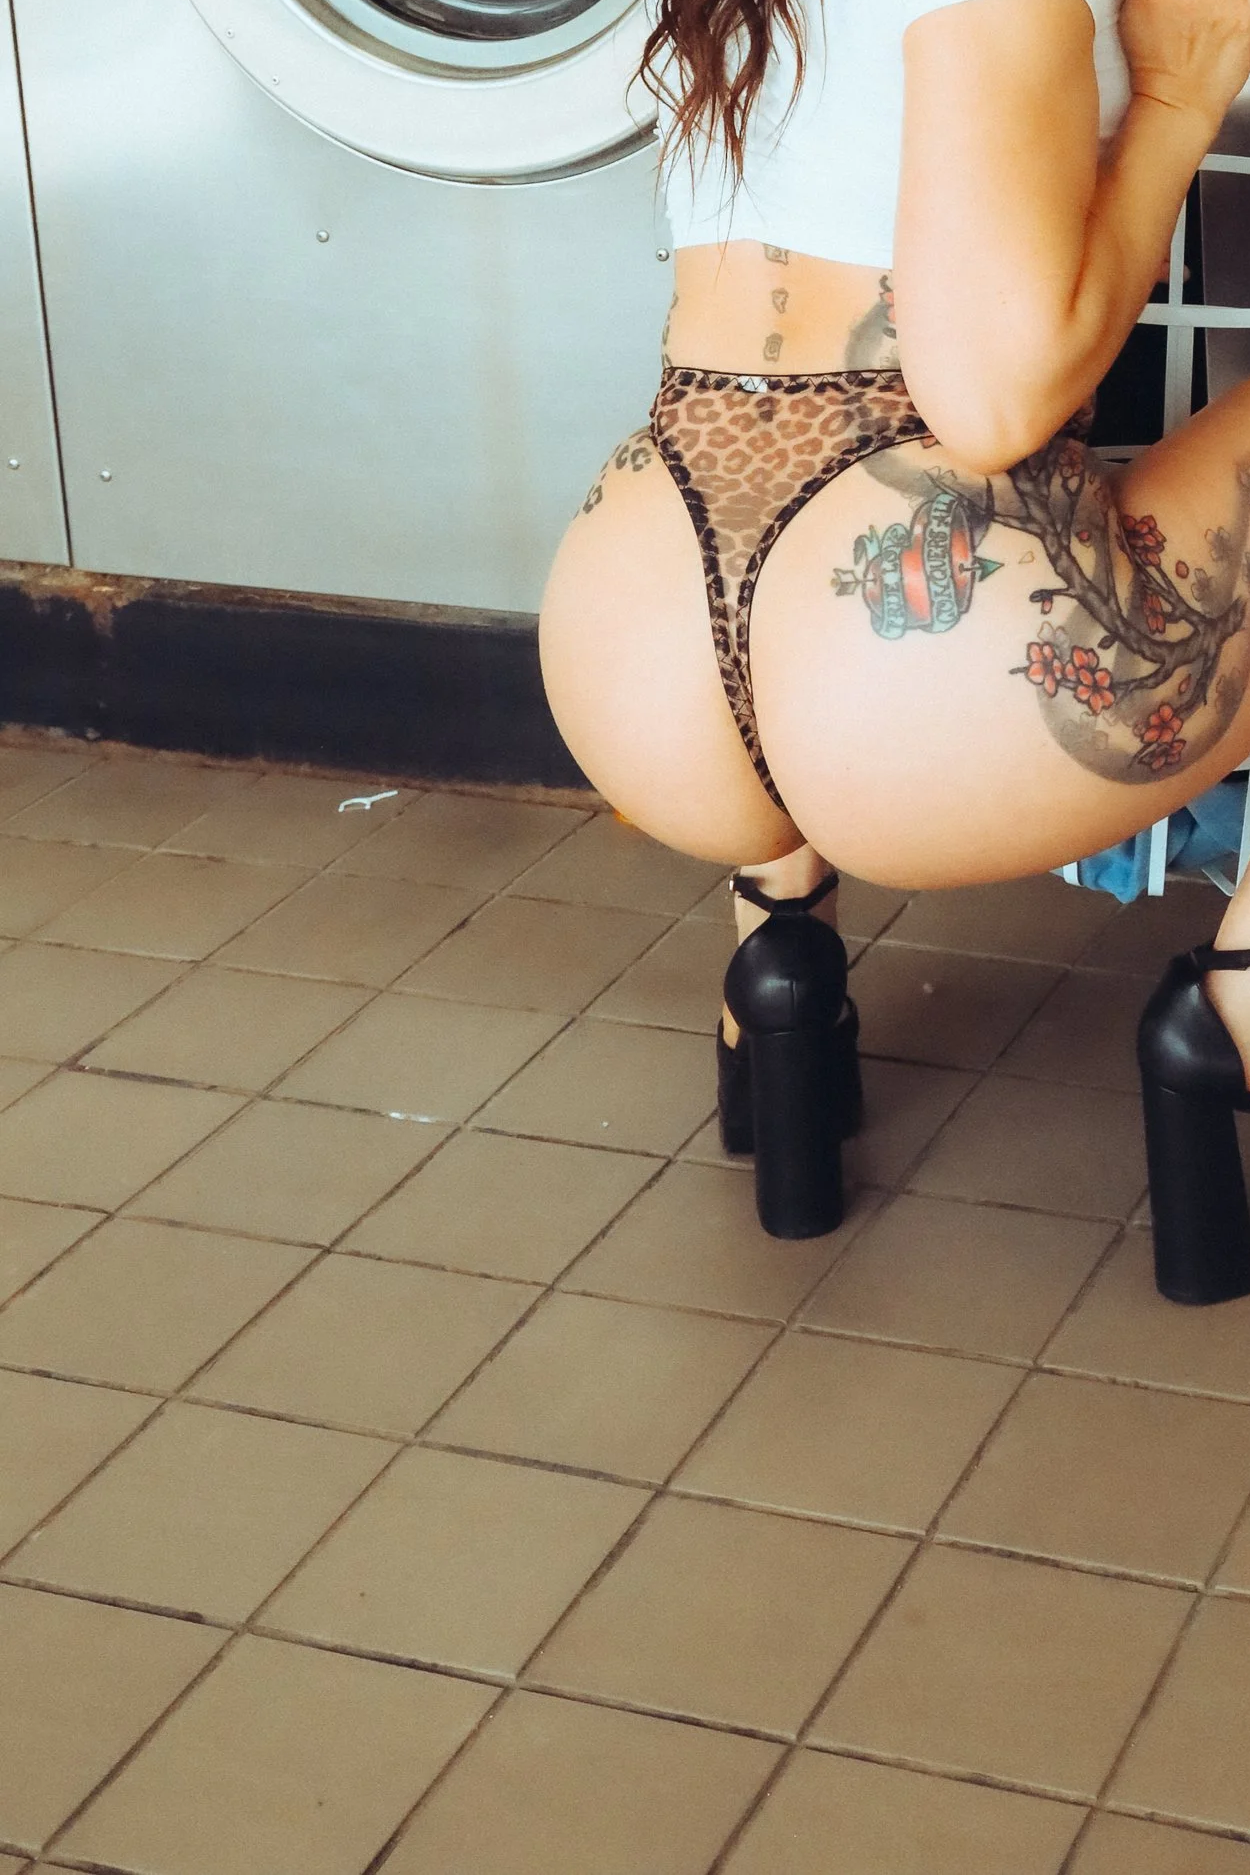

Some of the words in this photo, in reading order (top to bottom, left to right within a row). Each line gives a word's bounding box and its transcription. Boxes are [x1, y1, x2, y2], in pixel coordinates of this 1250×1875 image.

[931, 498, 955, 527] ALL
[882, 527, 910, 573] LOVE
[927, 527, 957, 624] CONQUERS
[884, 582, 905, 632] TRUE
